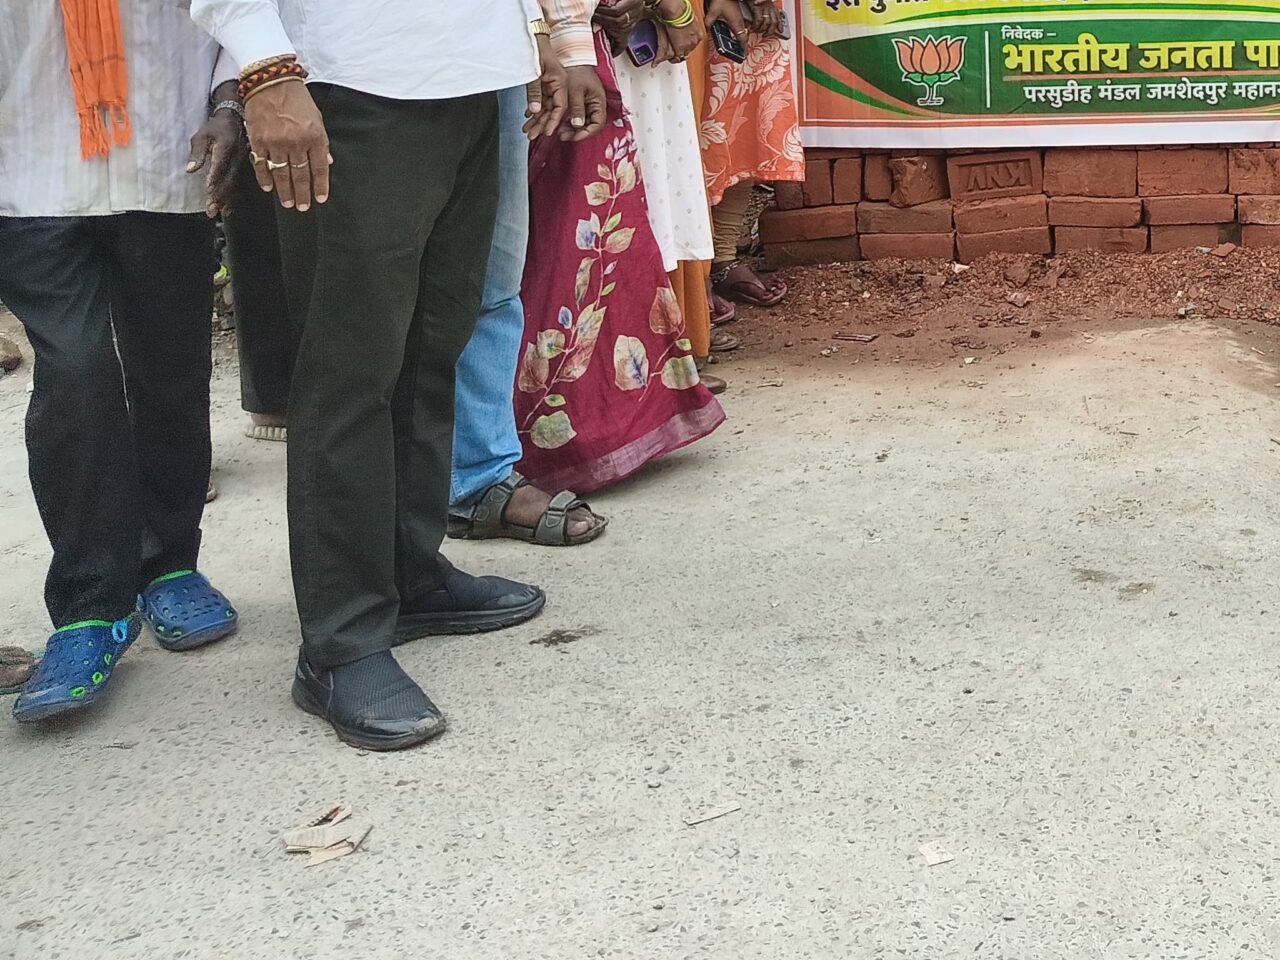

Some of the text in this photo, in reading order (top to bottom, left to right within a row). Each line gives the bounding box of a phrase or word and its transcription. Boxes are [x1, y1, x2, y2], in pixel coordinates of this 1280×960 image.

[1002, 33, 1130, 72] भारतीय
[1139, 41, 1234, 70] जनता
[1023, 80, 1092, 107] परसुडीह
[1098, 80, 1141, 100] मंडल
[1147, 78, 1226, 104] जमशेदपुर
[966, 160, 1027, 192] KNV
